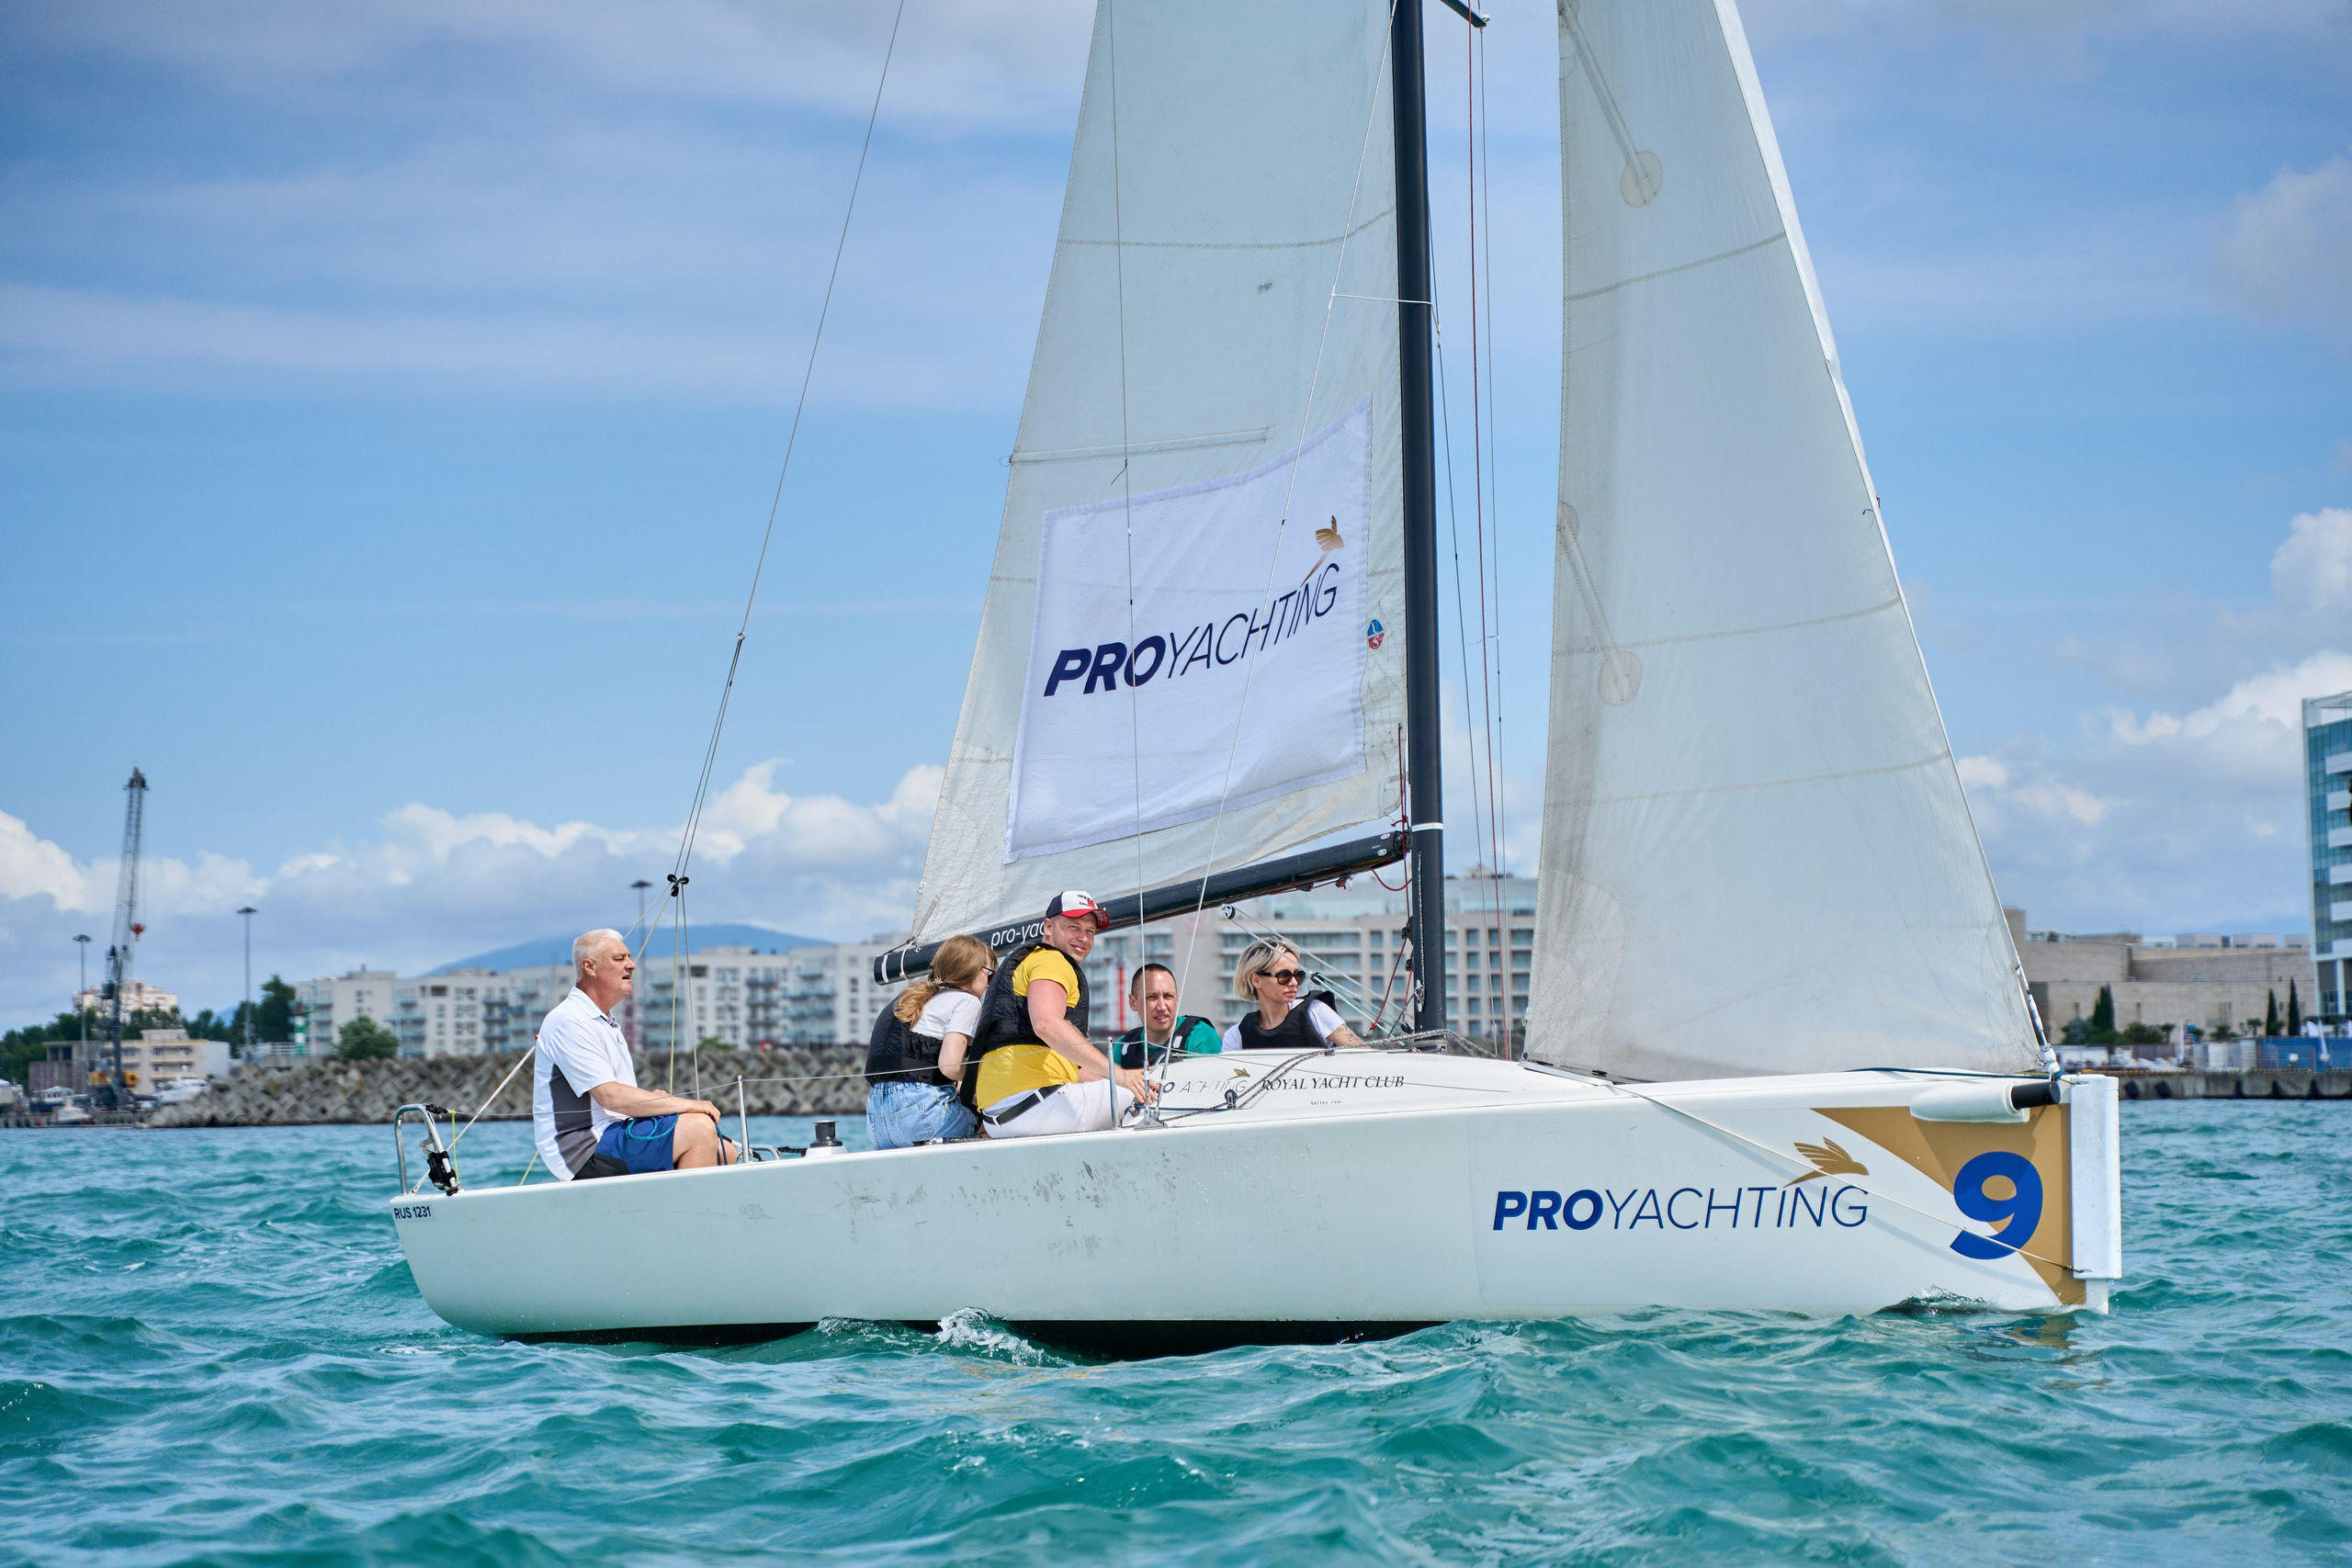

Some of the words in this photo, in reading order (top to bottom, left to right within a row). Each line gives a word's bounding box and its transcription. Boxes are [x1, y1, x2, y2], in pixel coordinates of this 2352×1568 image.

[1044, 563, 1340, 697] PROYACHTING
[1261, 1078, 1306, 1090] ROYAL
[1312, 1077, 1361, 1089] YACHT
[1365, 1076, 1404, 1088] CLUB
[393, 1207, 412, 1219] RUS
[413, 1205, 431, 1218] 1231
[1493, 1186, 1870, 1231] PROYACHTING
[1950, 1151, 2043, 1260] 9
